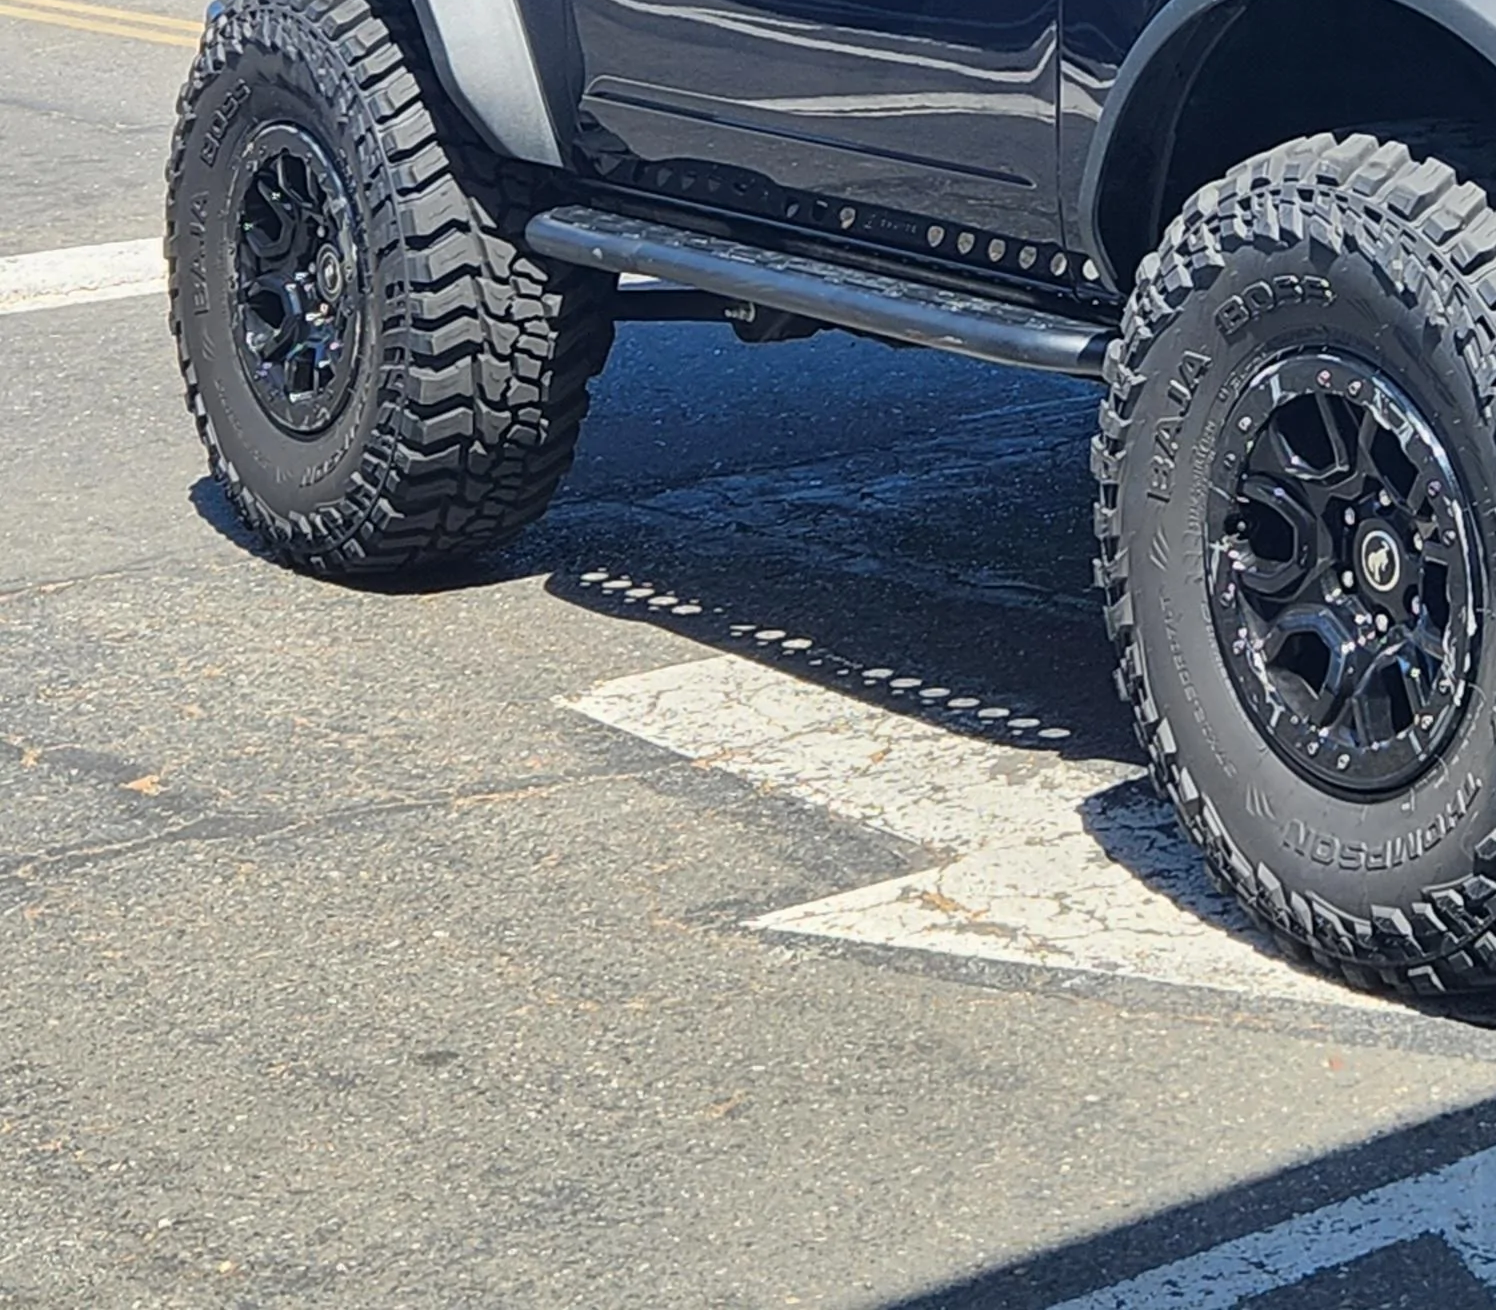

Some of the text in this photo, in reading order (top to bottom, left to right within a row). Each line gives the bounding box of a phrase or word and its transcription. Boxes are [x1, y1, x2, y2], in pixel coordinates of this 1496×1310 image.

[1146, 349, 1212, 504] BAJA
[1213, 274, 1337, 338] BOSS
[1282, 771, 1484, 872] THOMPSON
